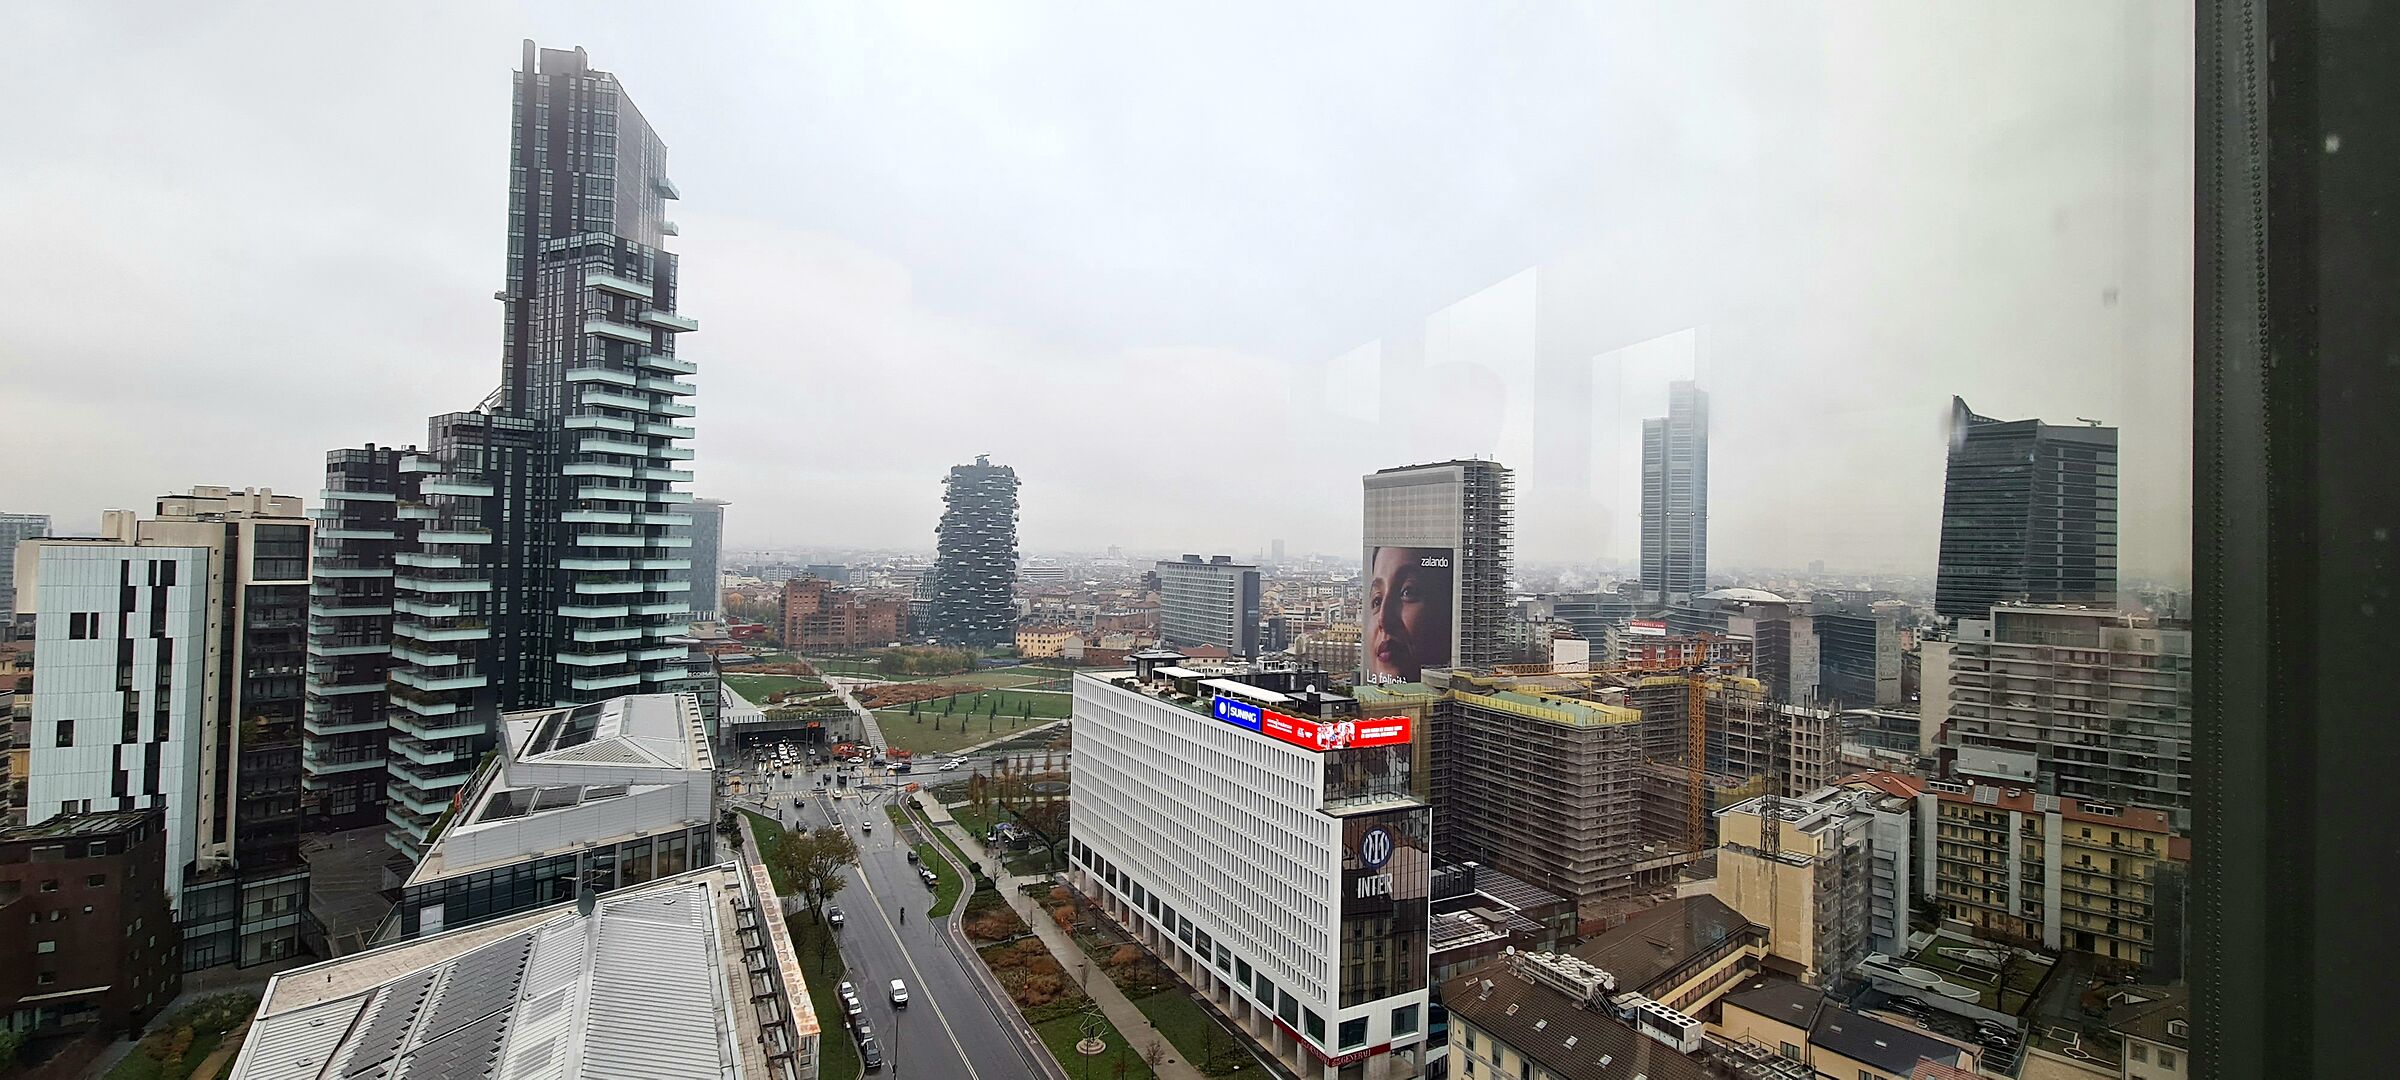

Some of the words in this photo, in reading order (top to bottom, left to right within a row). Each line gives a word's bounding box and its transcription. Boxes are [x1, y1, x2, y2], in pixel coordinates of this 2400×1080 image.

[1421, 556, 1449, 567] zalando
[1366, 668, 1377, 684] La
[1230, 706, 1257, 723] SUNING
[1357, 873, 1393, 899] INTER
